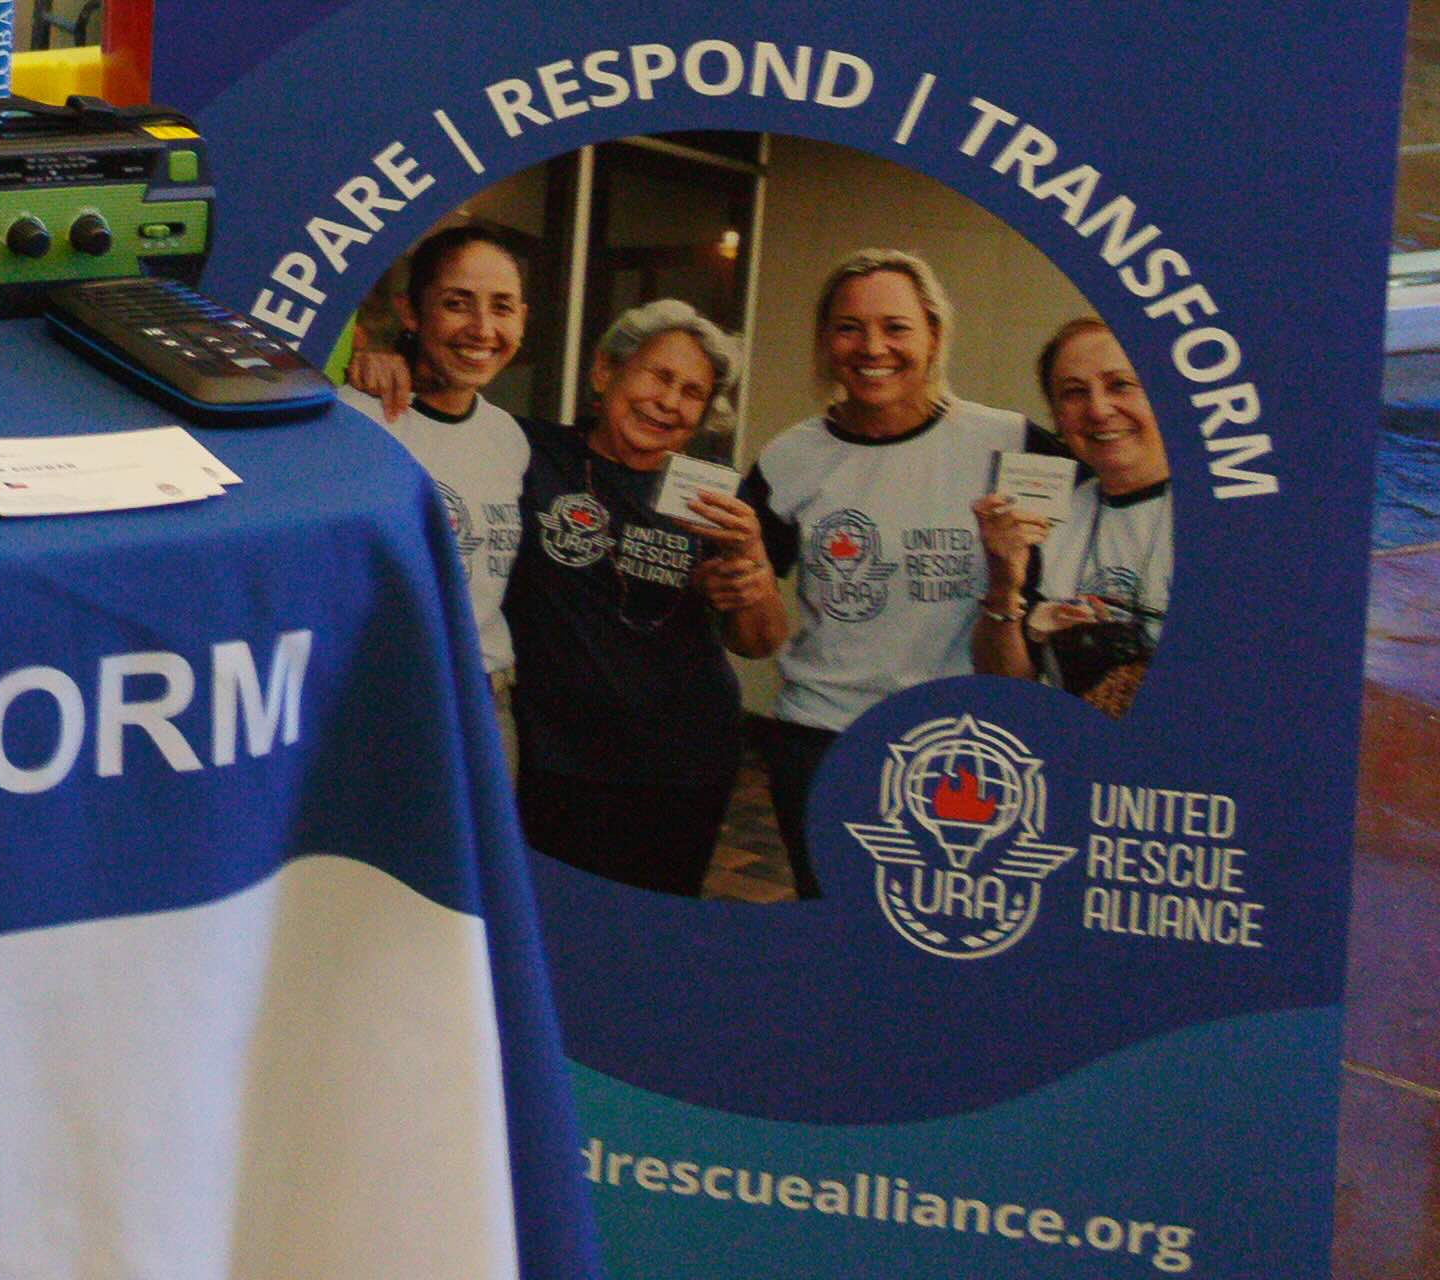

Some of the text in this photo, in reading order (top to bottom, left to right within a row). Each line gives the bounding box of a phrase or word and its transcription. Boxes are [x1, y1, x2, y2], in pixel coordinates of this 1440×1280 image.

[251, 37, 1279, 502] EPARE RESPOND TRANSFORM
[904, 527, 973, 552] UNITED
[1090, 781, 1237, 840] UNITED
[1086, 837, 1247, 894] RESCUE
[913, 870, 1008, 922] URA
[1083, 890, 1265, 949] ALLIANCE
